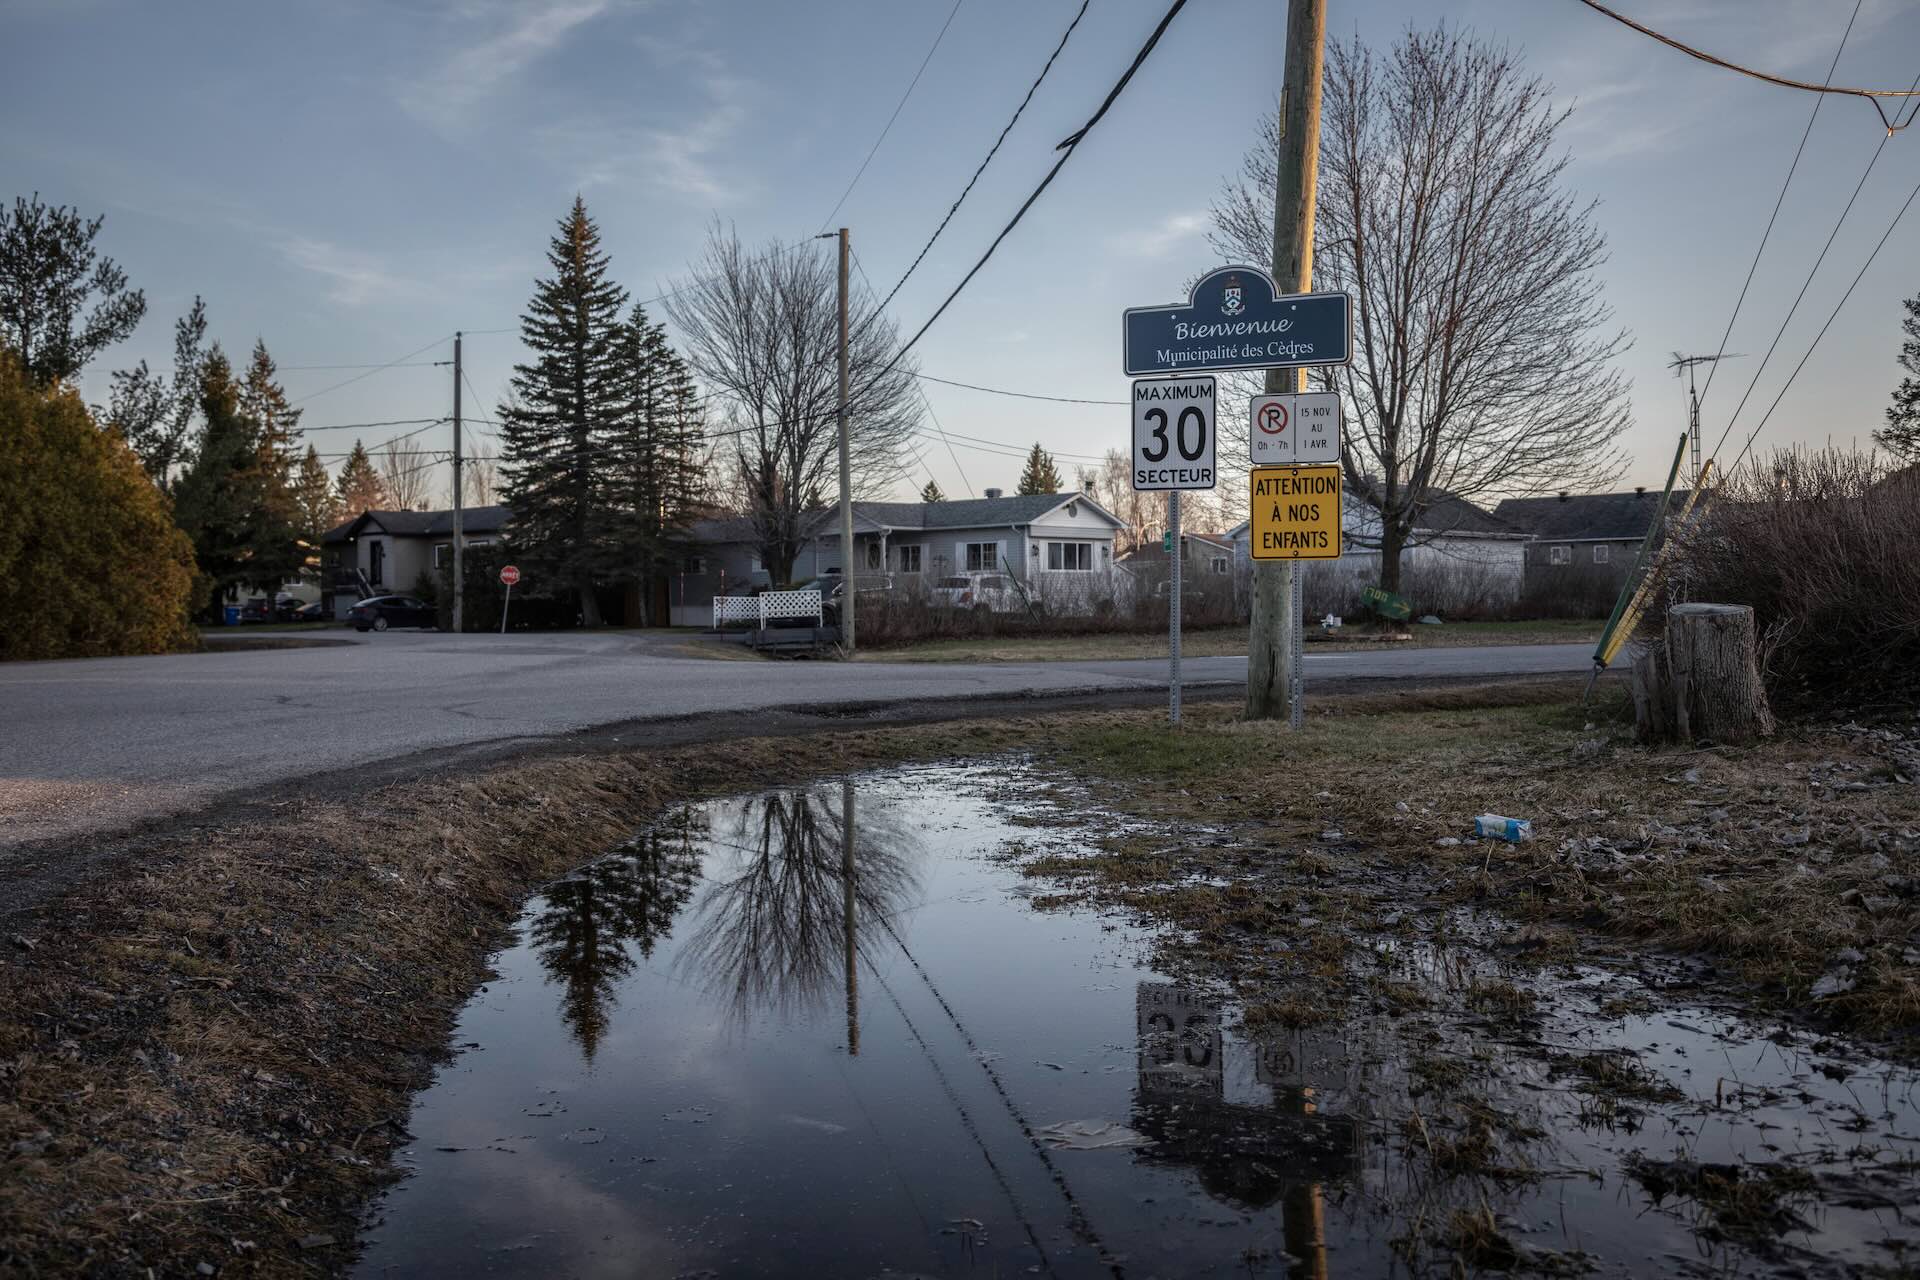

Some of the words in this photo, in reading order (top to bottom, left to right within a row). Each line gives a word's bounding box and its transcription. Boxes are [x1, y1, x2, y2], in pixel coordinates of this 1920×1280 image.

[1174, 317, 1295, 341] Bienvenue
[1157, 344, 1237, 364] Municipalité
[1241, 343, 1263, 358] des
[1267, 340, 1314, 356] Cèdres
[1136, 384, 1212, 401] MAXIMUM
[1301, 407, 1310, 417] 15
[1141, 406, 1206, 462] 30
[1311, 423, 1323, 433] AU
[1278, 440, 1288, 450] 7h
[1137, 468, 1211, 484] SECTEUR
[1256, 476, 1336, 496] ATTENTION
[1271, 501, 1282, 522] À
[1289, 504, 1320, 522] NOS
[1263, 531, 1328, 549] ENFANTS
